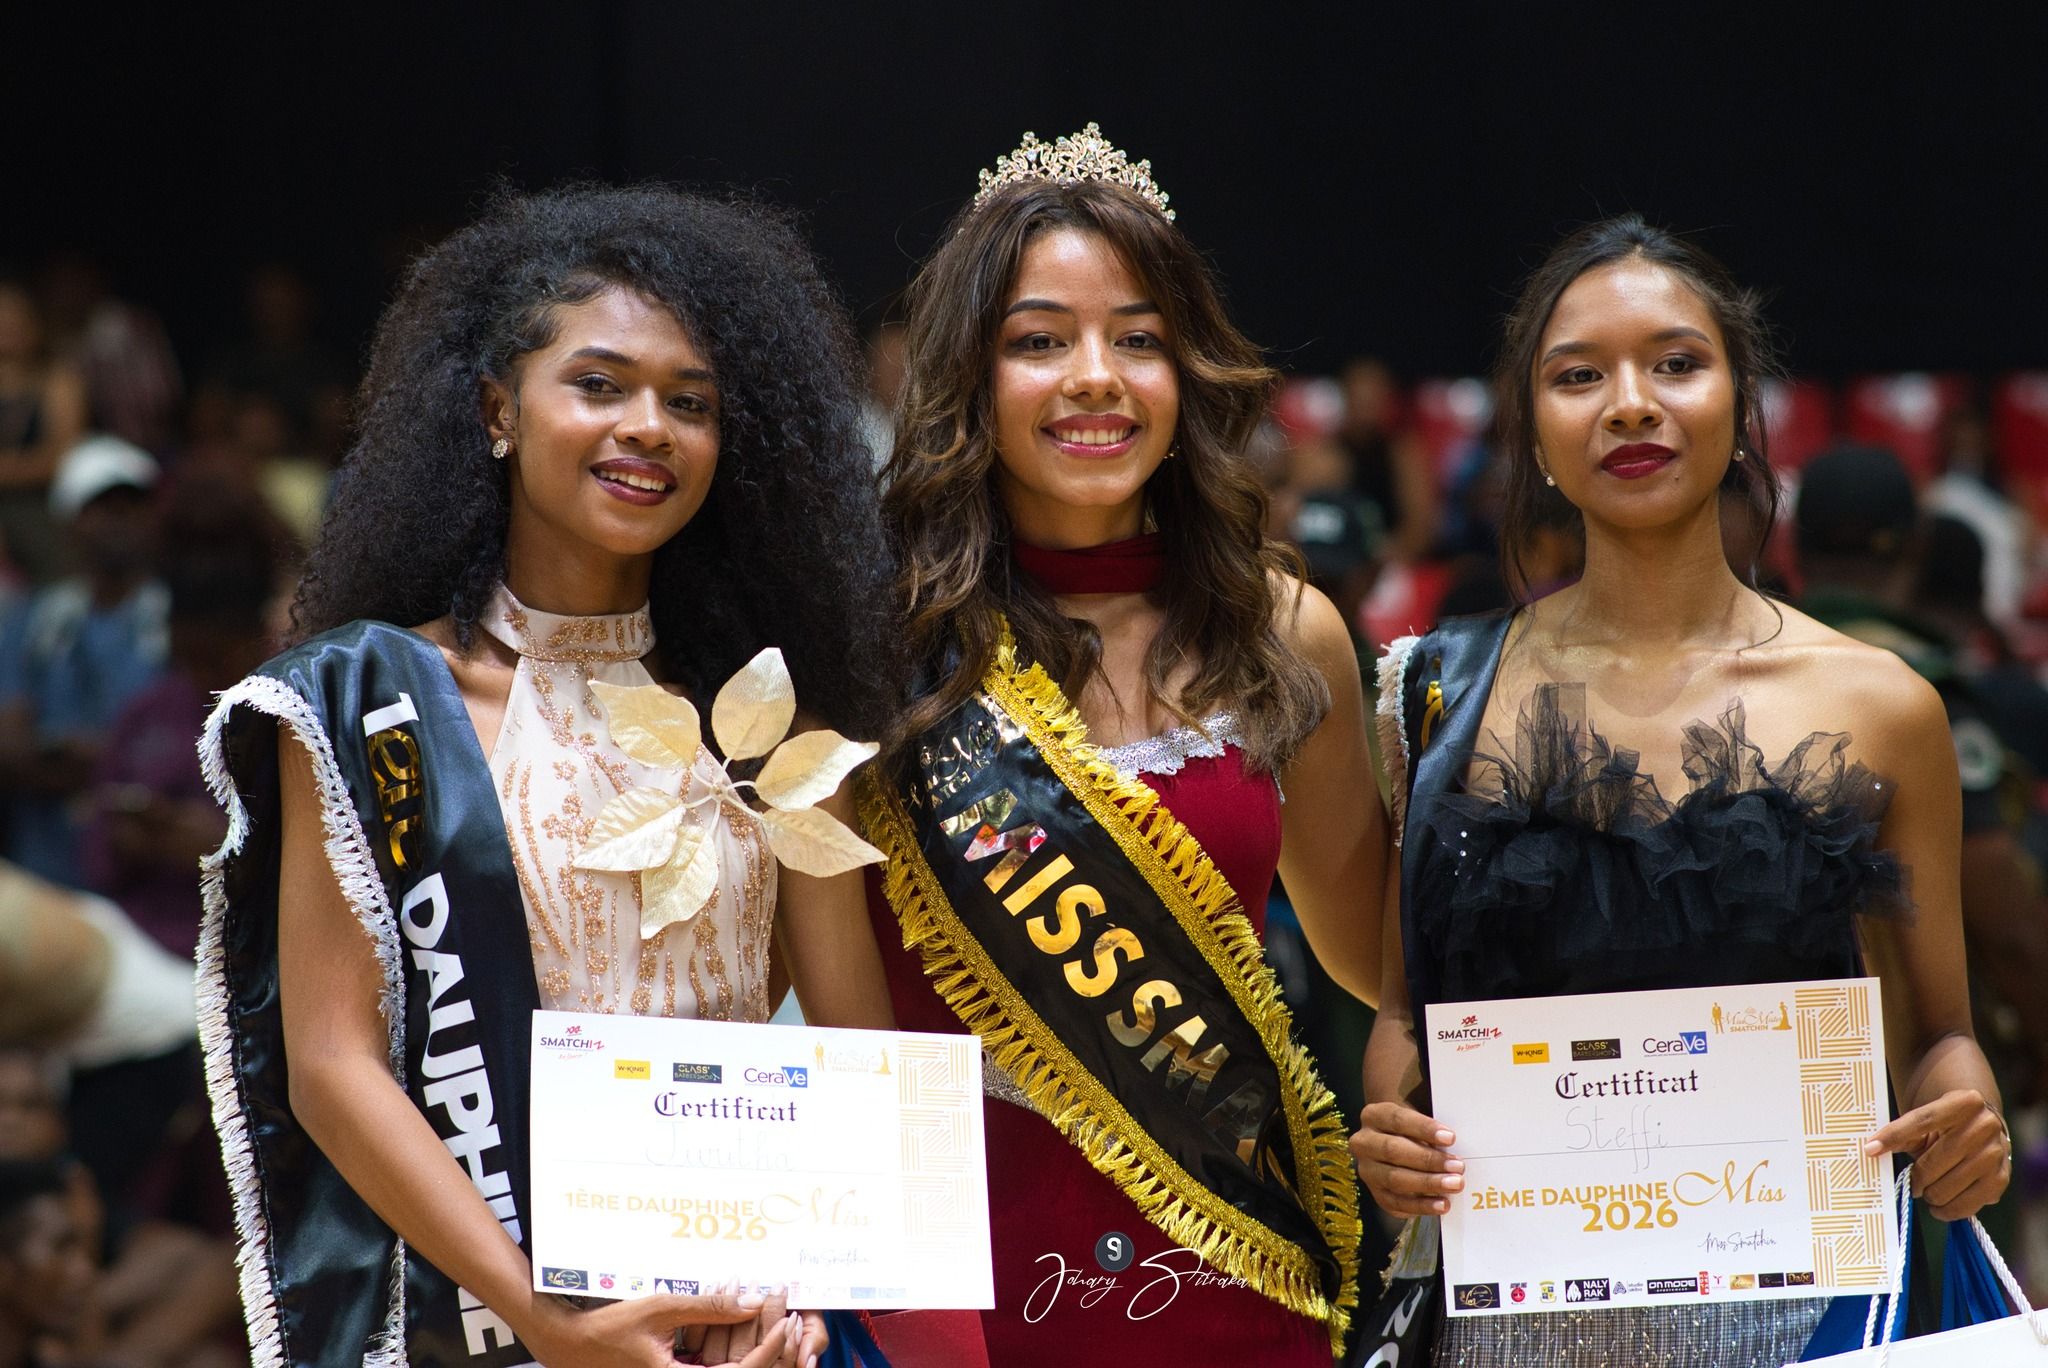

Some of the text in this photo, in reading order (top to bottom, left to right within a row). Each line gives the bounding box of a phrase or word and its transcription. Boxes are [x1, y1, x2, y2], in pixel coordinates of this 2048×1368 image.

[939, 787, 1277, 1178] MISS SMA
[1729, 1024, 1769, 1033] SMATCHIN
[1642, 1035, 1707, 1054] CeraVe
[744, 1067, 807, 1086] CeraVe
[1555, 1069, 1699, 1100] Certificat
[401, 872, 523, 1356] DAUPHE
[654, 1091, 798, 1122] Certificat
[1565, 1104, 1669, 1175] Steffi
[1471, 1159, 1787, 1210] 2ÈME DAUPHINE Miss
[564, 1186, 873, 1228] 1ÈRE DAUPHINE Miss
[1581, 1198, 1679, 1232] 2026
[670, 1212, 768, 1242] 2026
[672, 1280, 698, 1290] NALY
[1583, 1280, 1608, 1289] NALY
[1584, 1288, 1604, 1298] RAK
